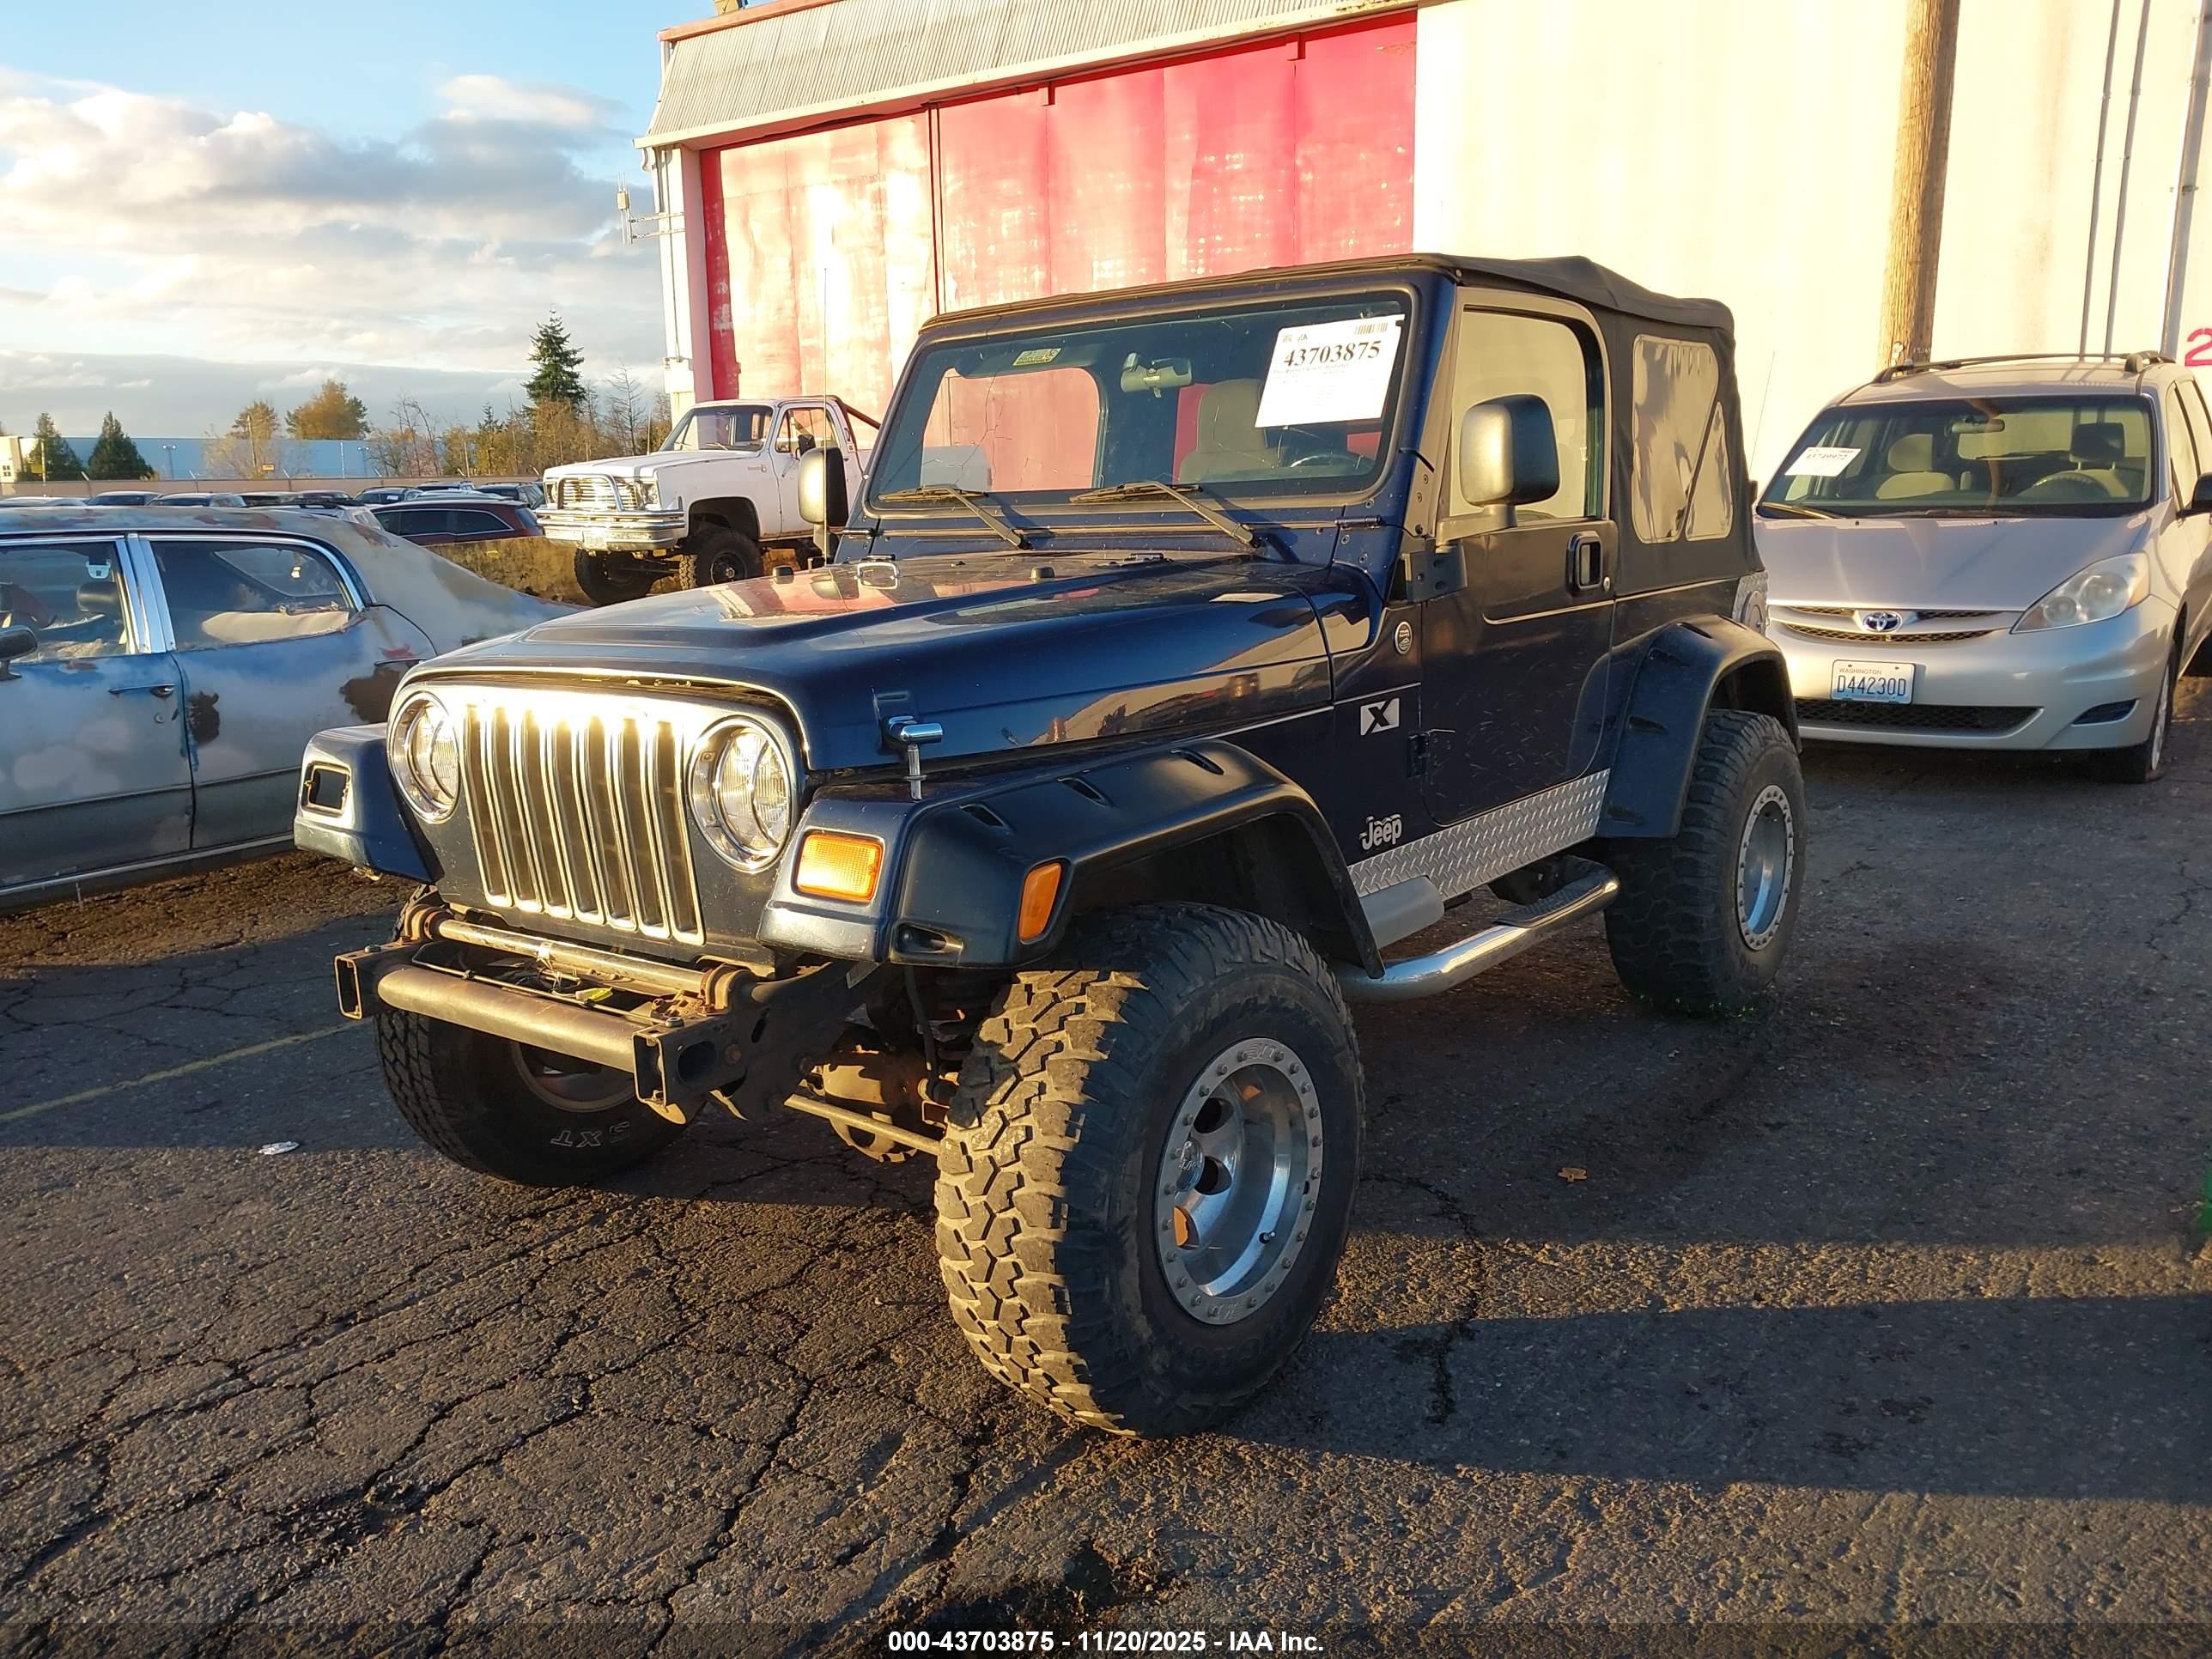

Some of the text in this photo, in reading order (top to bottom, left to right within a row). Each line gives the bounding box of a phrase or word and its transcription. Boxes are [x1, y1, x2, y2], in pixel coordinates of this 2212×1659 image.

[1284, 341, 1382, 367] 43703875
[1837, 675, 1906, 696] D44230D
[1359, 813, 1402, 850] Jeep
